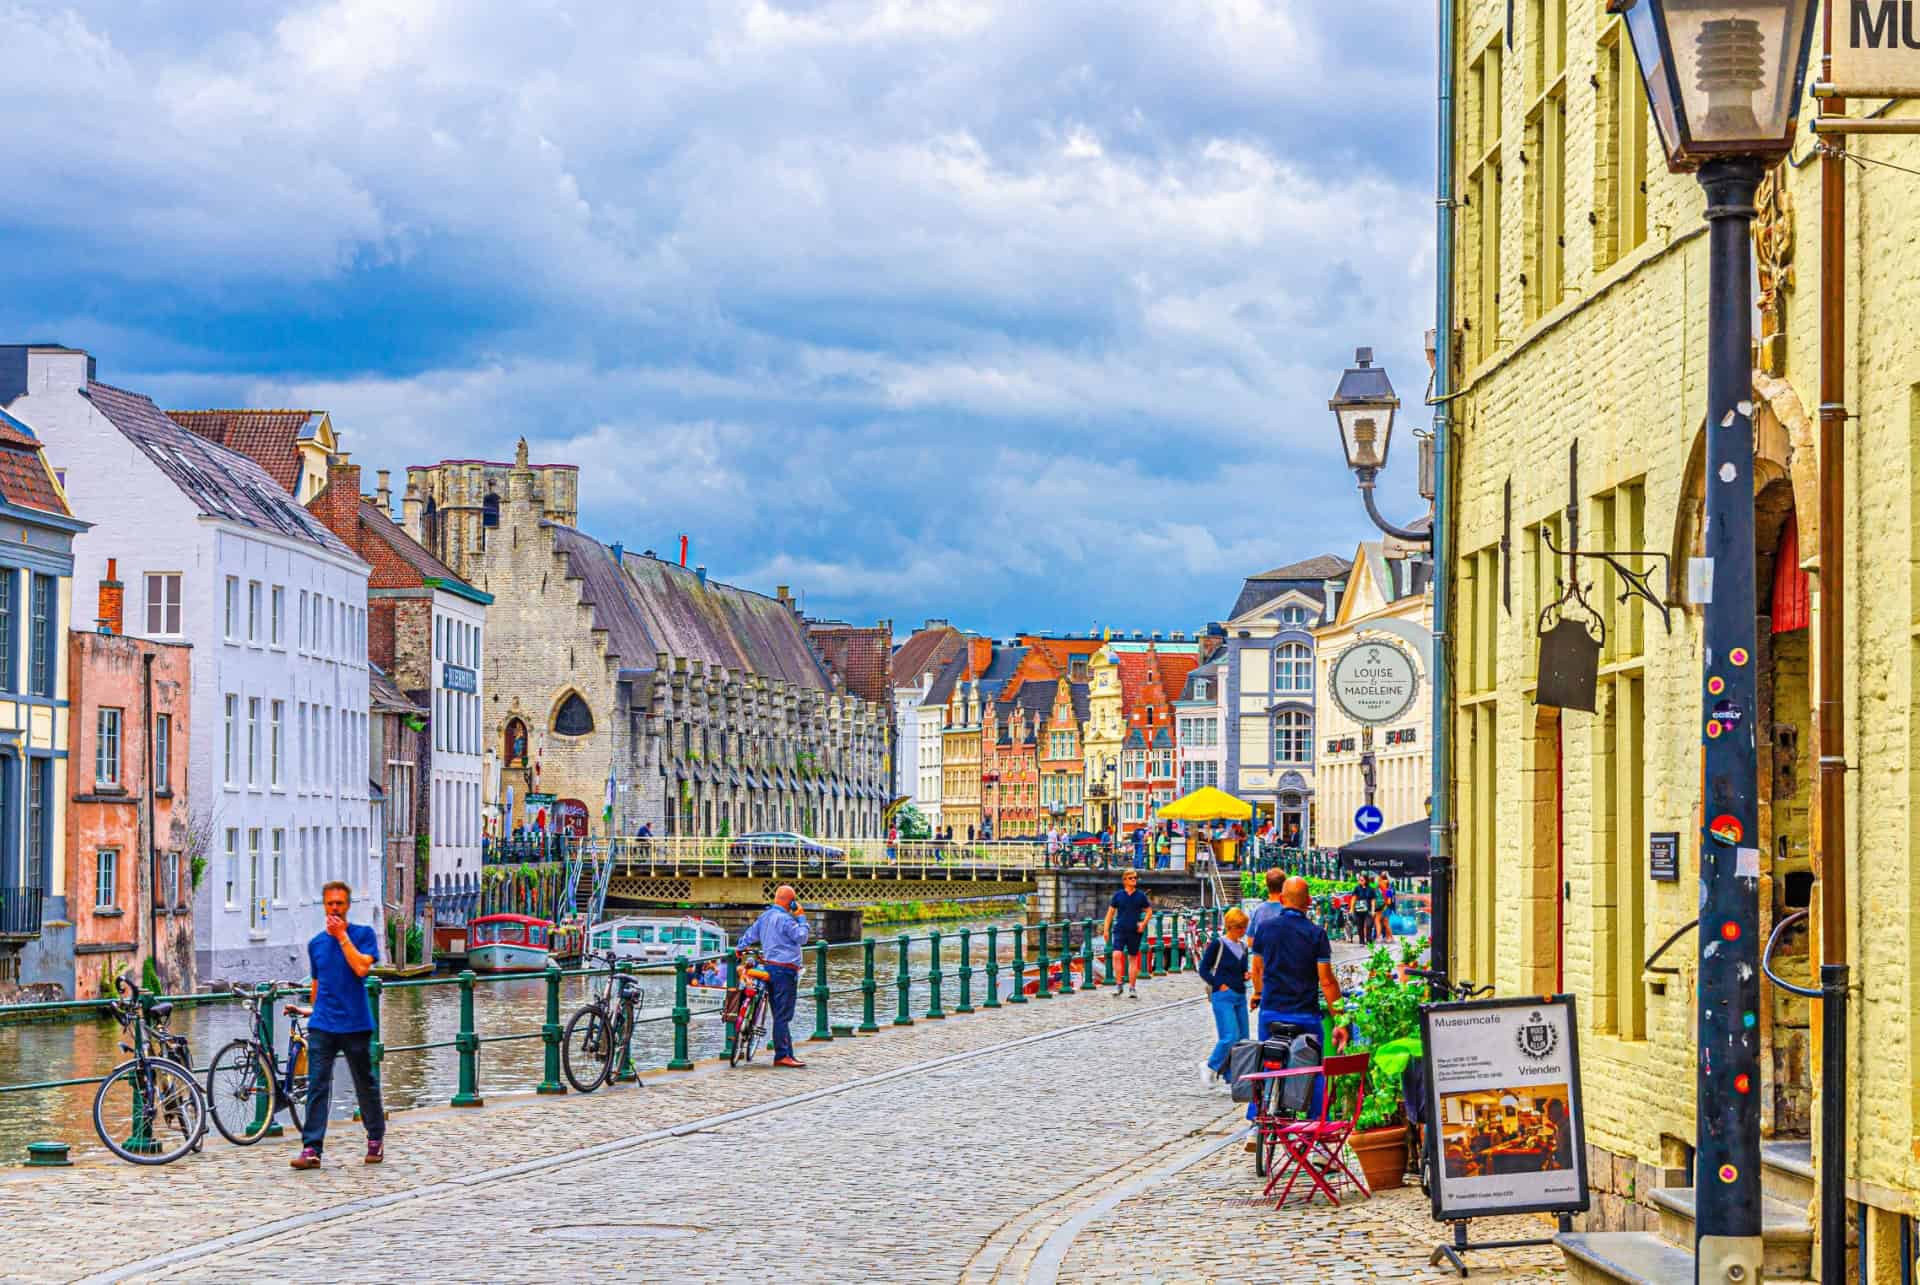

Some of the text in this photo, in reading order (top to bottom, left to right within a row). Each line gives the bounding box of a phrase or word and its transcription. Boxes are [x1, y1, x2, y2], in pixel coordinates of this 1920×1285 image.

[1354, 668, 1393, 678] LOUISE
[1345, 687, 1403, 696] MADELEINE
[1518, 1065, 1561, 1075] Vrienden
